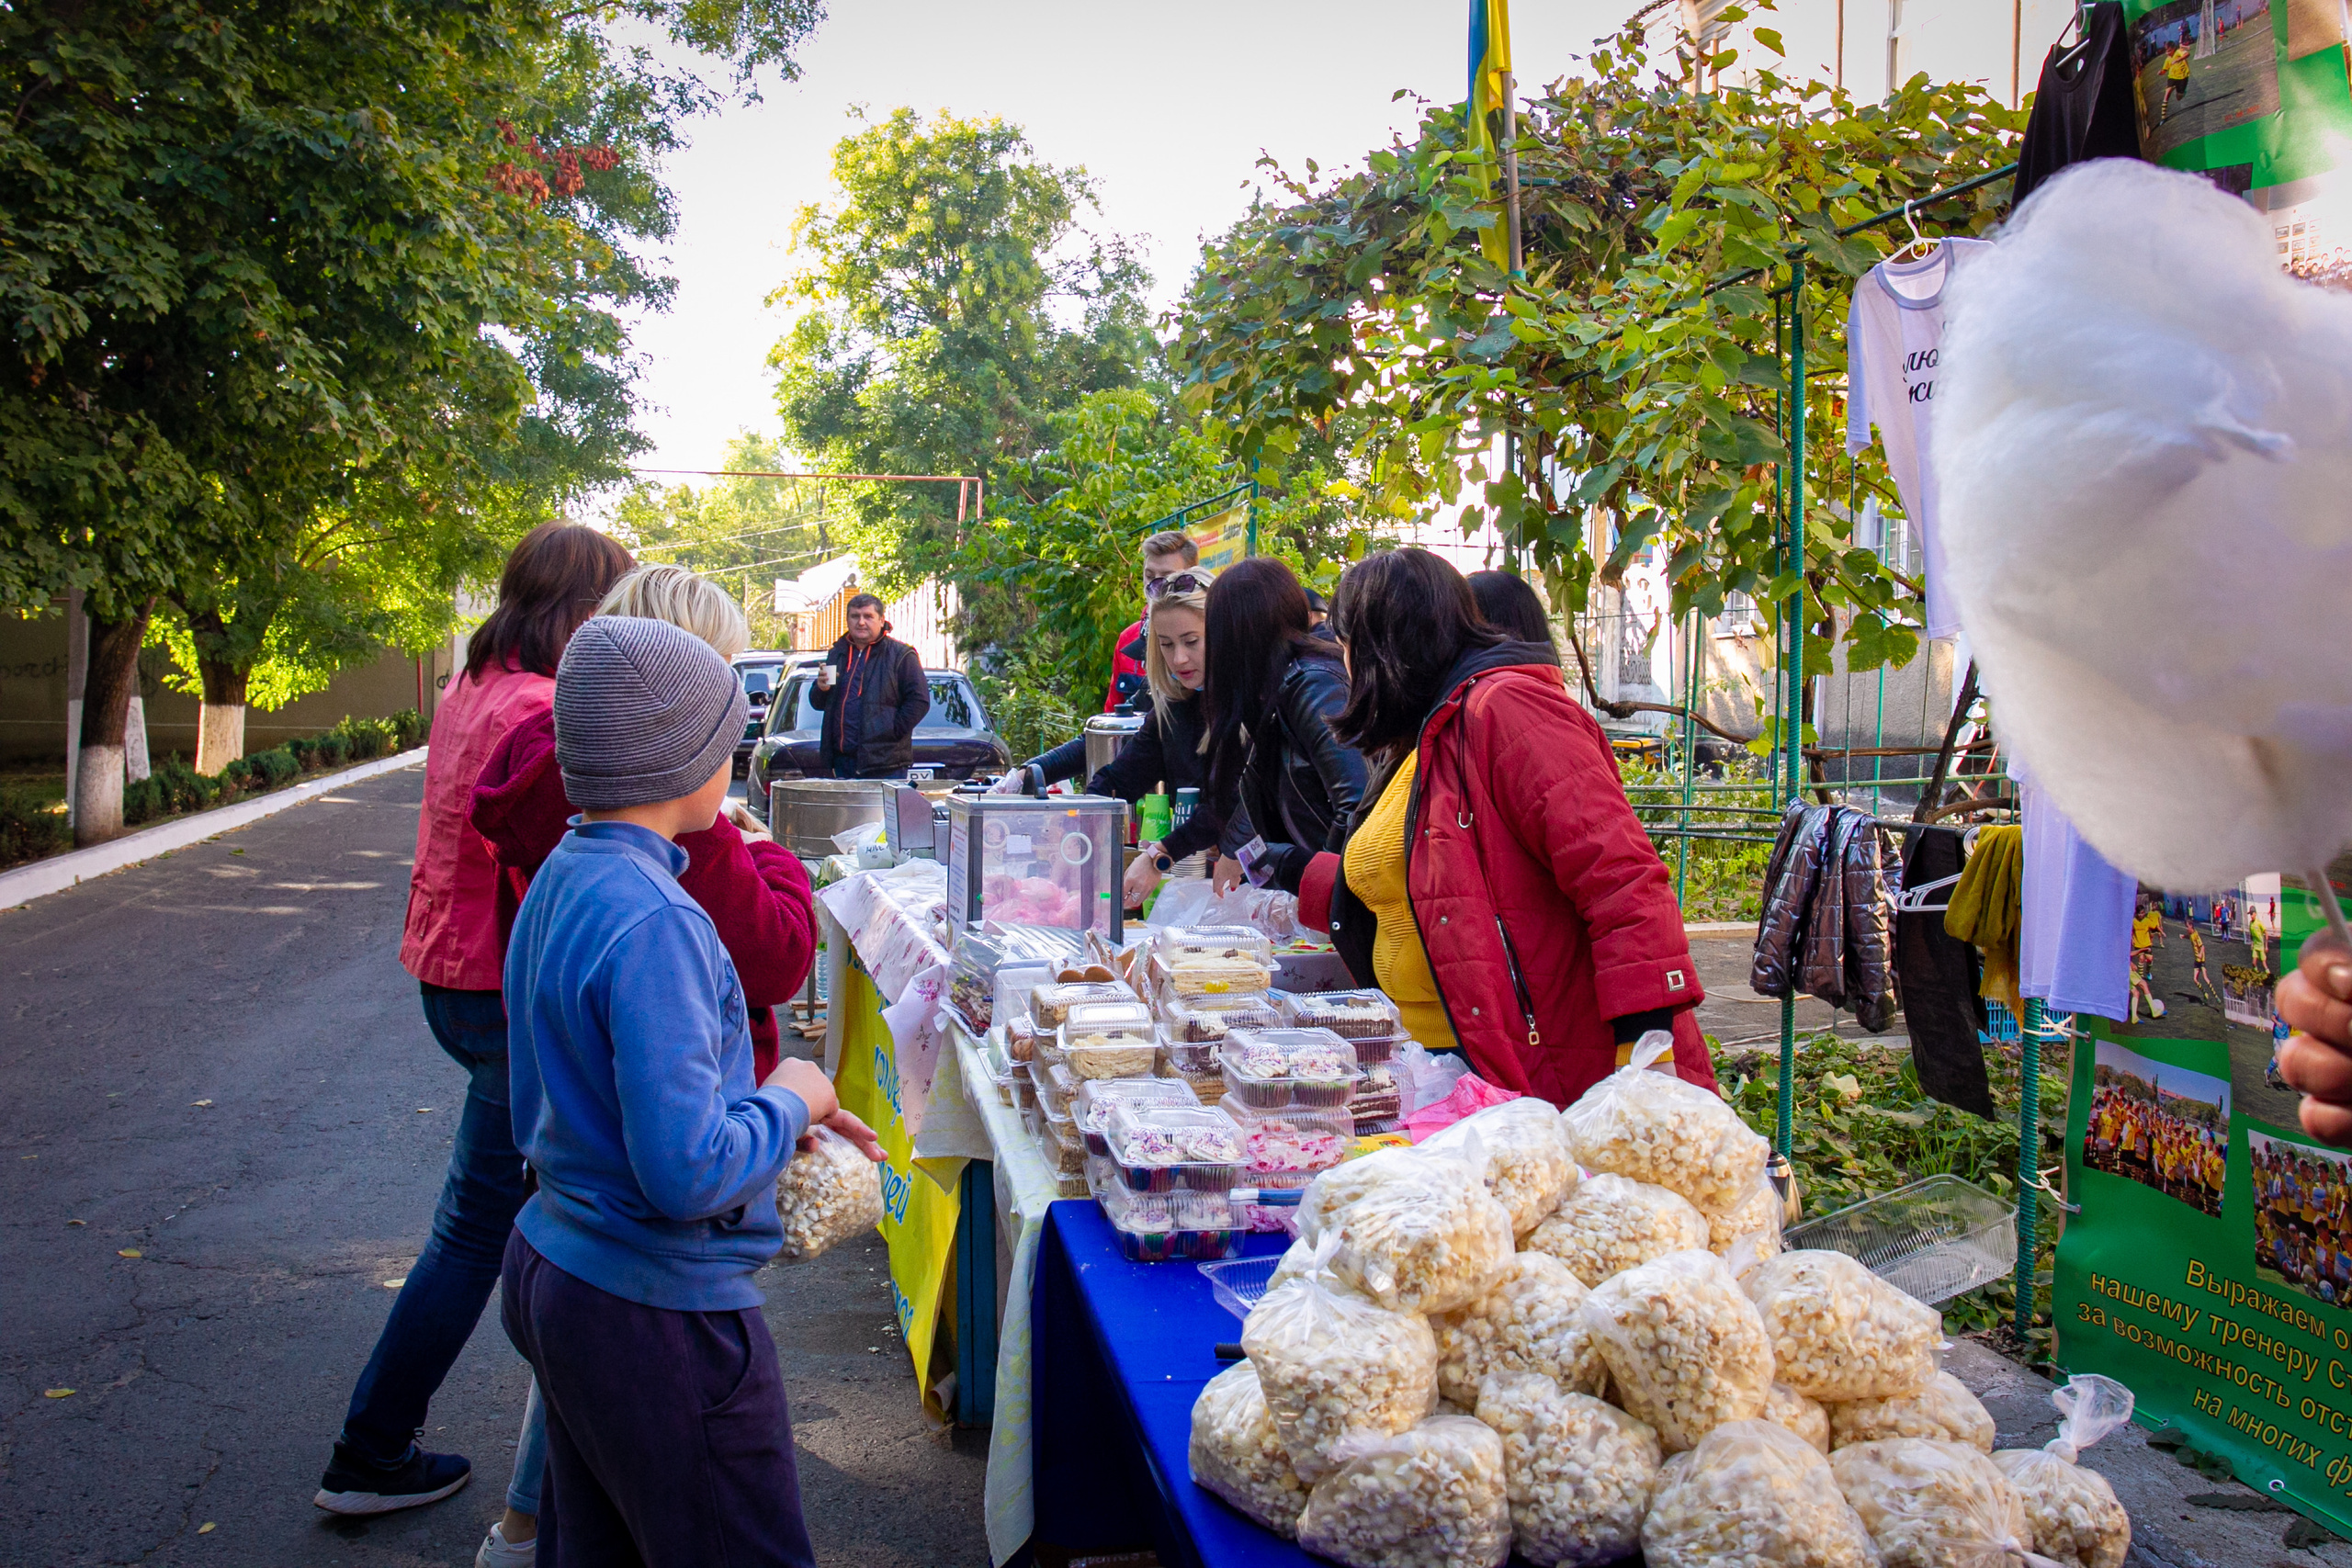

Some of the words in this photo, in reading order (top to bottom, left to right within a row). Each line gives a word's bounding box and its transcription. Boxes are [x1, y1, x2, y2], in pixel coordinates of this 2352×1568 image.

[2076, 1301, 2107, 1328] за
[2112, 1314, 2291, 1409] возможность
[2090, 1271, 2201, 1333] нашему
[2208, 1313, 2320, 1382] тренеру
[2185, 1258, 2326, 1340] Выражаем
[2334, 1327, 2352, 1355] о
[2192, 1387, 2223, 1418] на
[2226, 1404, 2324, 1470] многих
